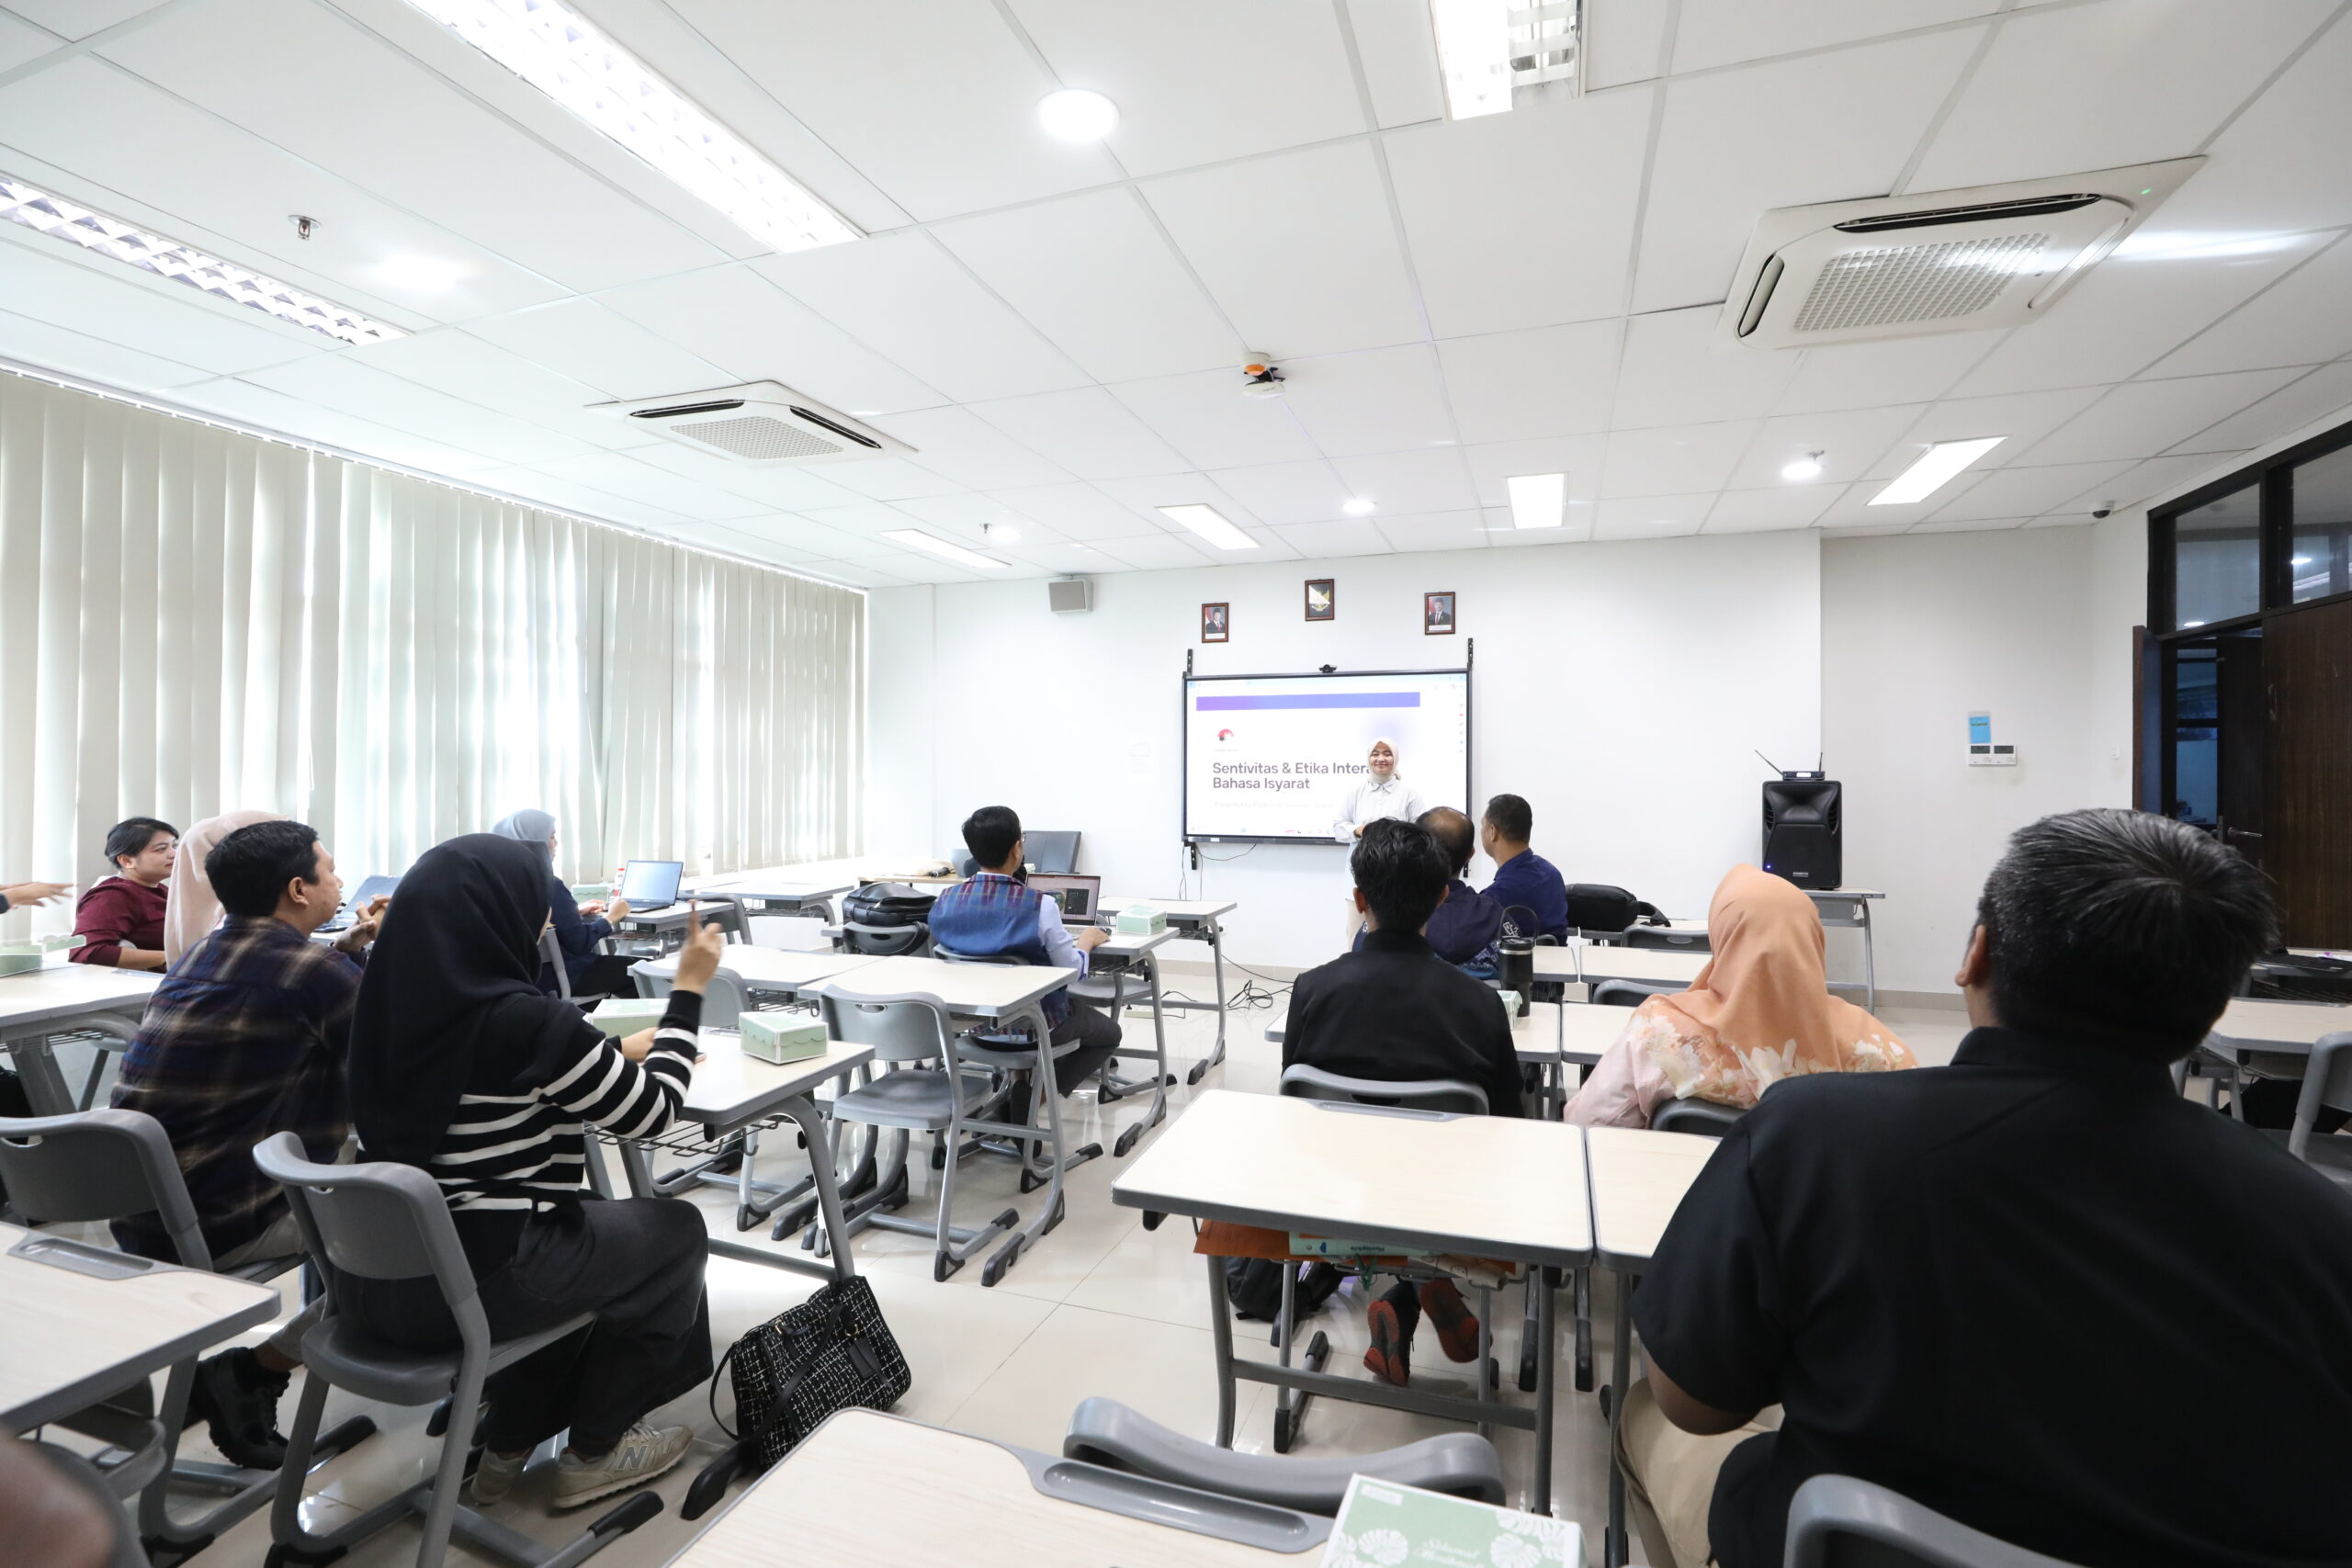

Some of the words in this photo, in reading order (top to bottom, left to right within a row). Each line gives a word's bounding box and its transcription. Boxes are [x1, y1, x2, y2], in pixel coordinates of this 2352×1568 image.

[1213, 761, 1279, 774] Sentivitas
[1282, 761, 1292, 774] &
[1295, 761, 1329, 774] Etika
[1213, 776, 1261, 789] Bahasa
[1264, 776, 1310, 792] Isyarat
[617, 1445, 647, 1470] N
